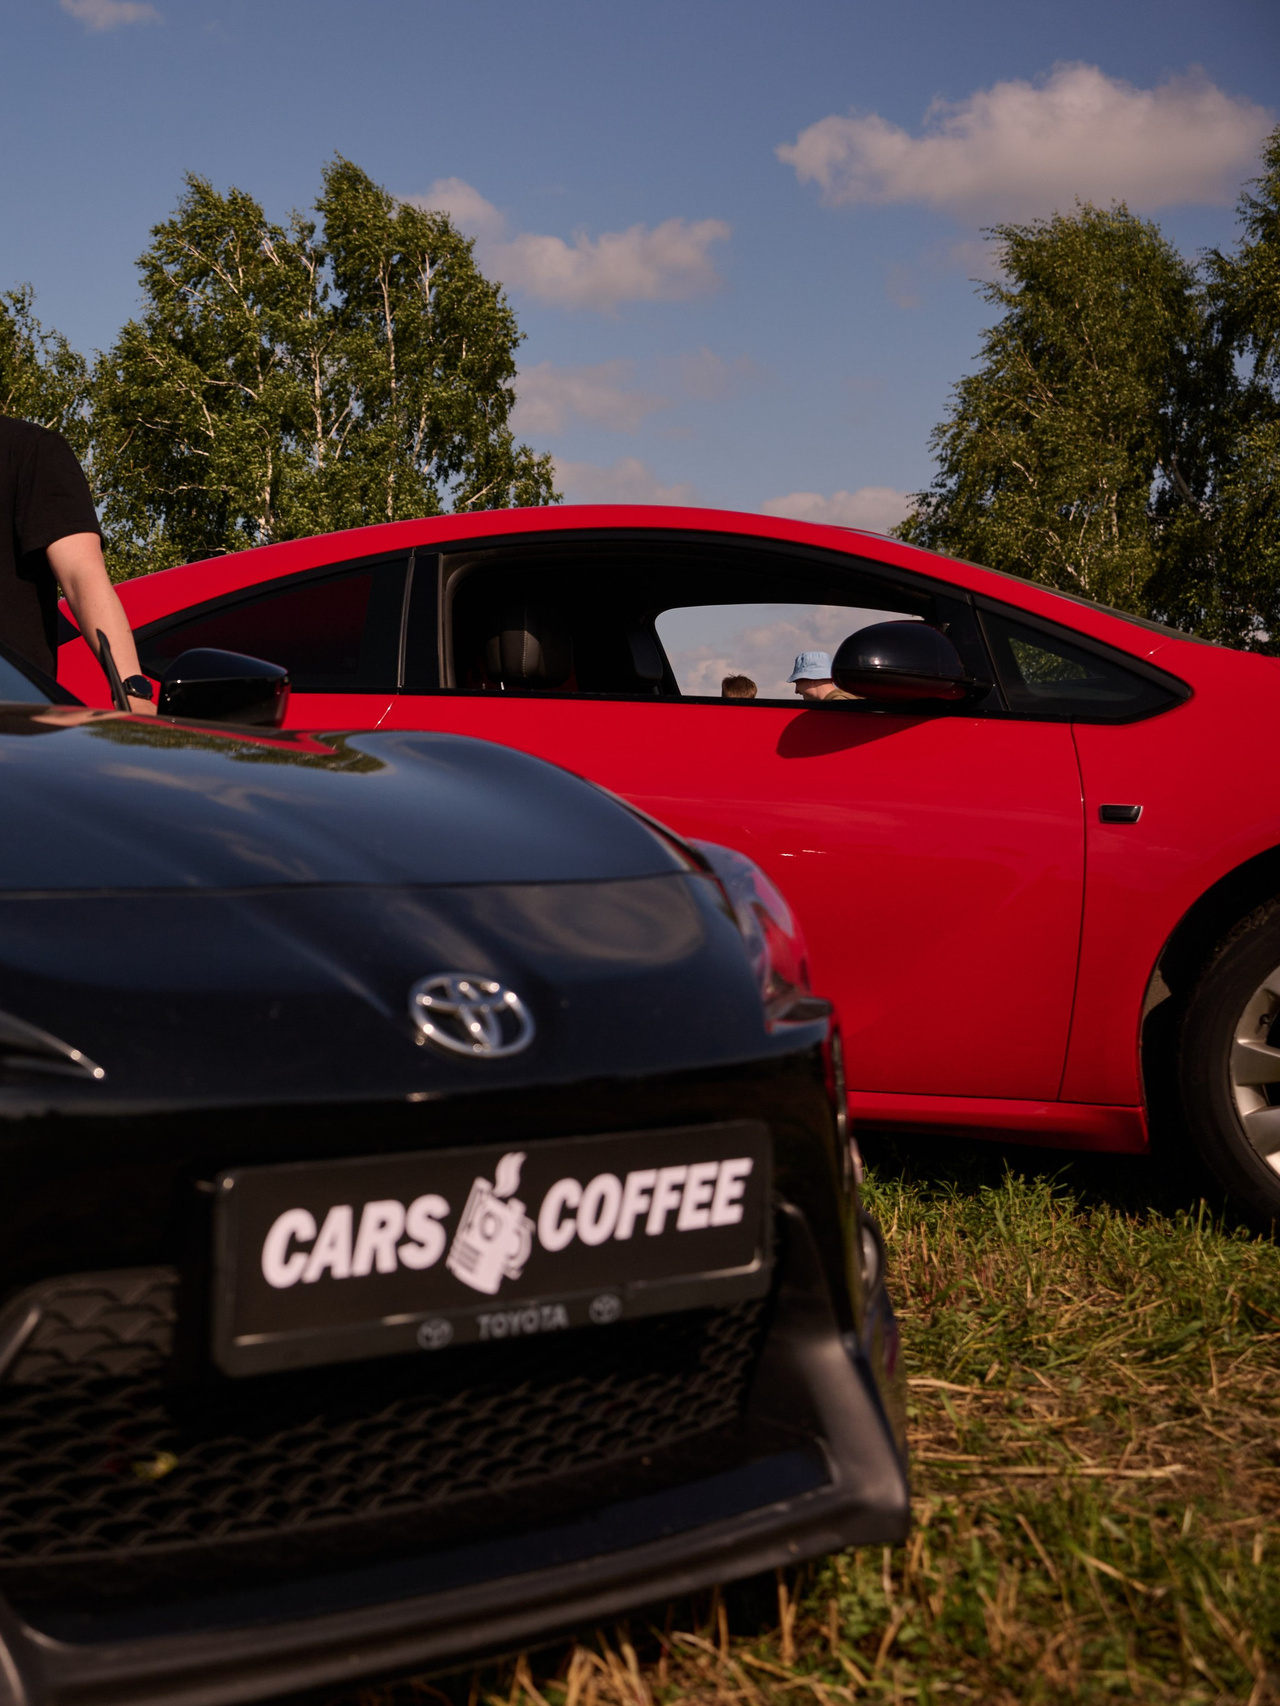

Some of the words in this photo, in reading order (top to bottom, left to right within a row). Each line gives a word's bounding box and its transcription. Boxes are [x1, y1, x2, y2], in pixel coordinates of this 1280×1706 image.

[261, 1195, 451, 1289] CARS
[538, 1157, 753, 1252] COFFEE
[478, 1304, 568, 1340] TOYOTA
